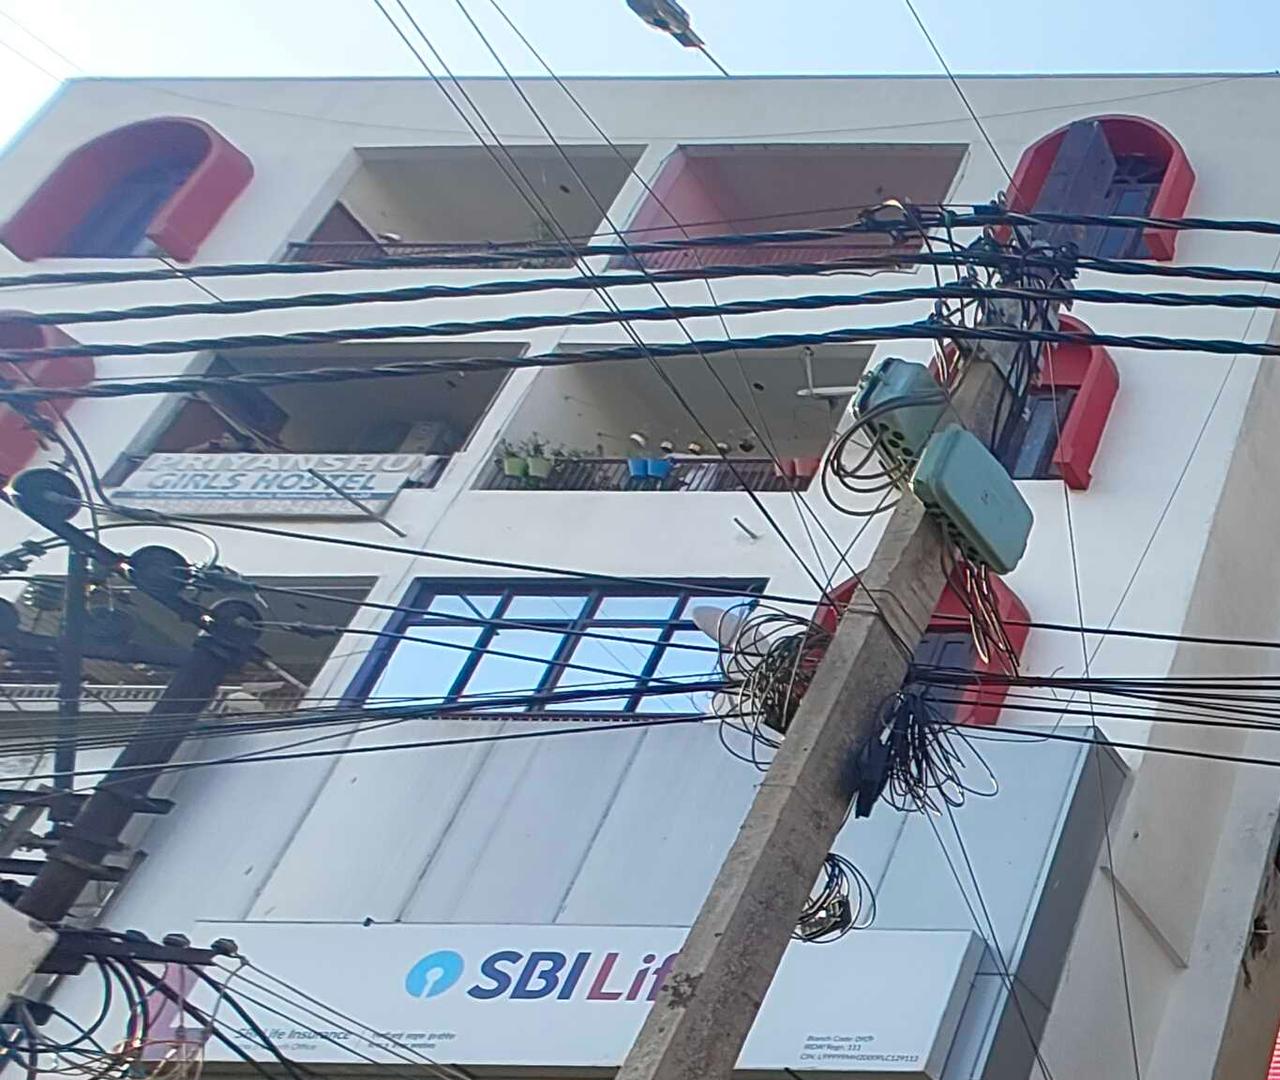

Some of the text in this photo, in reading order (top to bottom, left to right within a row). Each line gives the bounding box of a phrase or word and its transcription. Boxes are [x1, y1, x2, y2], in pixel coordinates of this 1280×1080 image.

[148, 472, 377, 490] GIRLS HOSTEL
[467, 950, 681, 1001] SBI Lif
